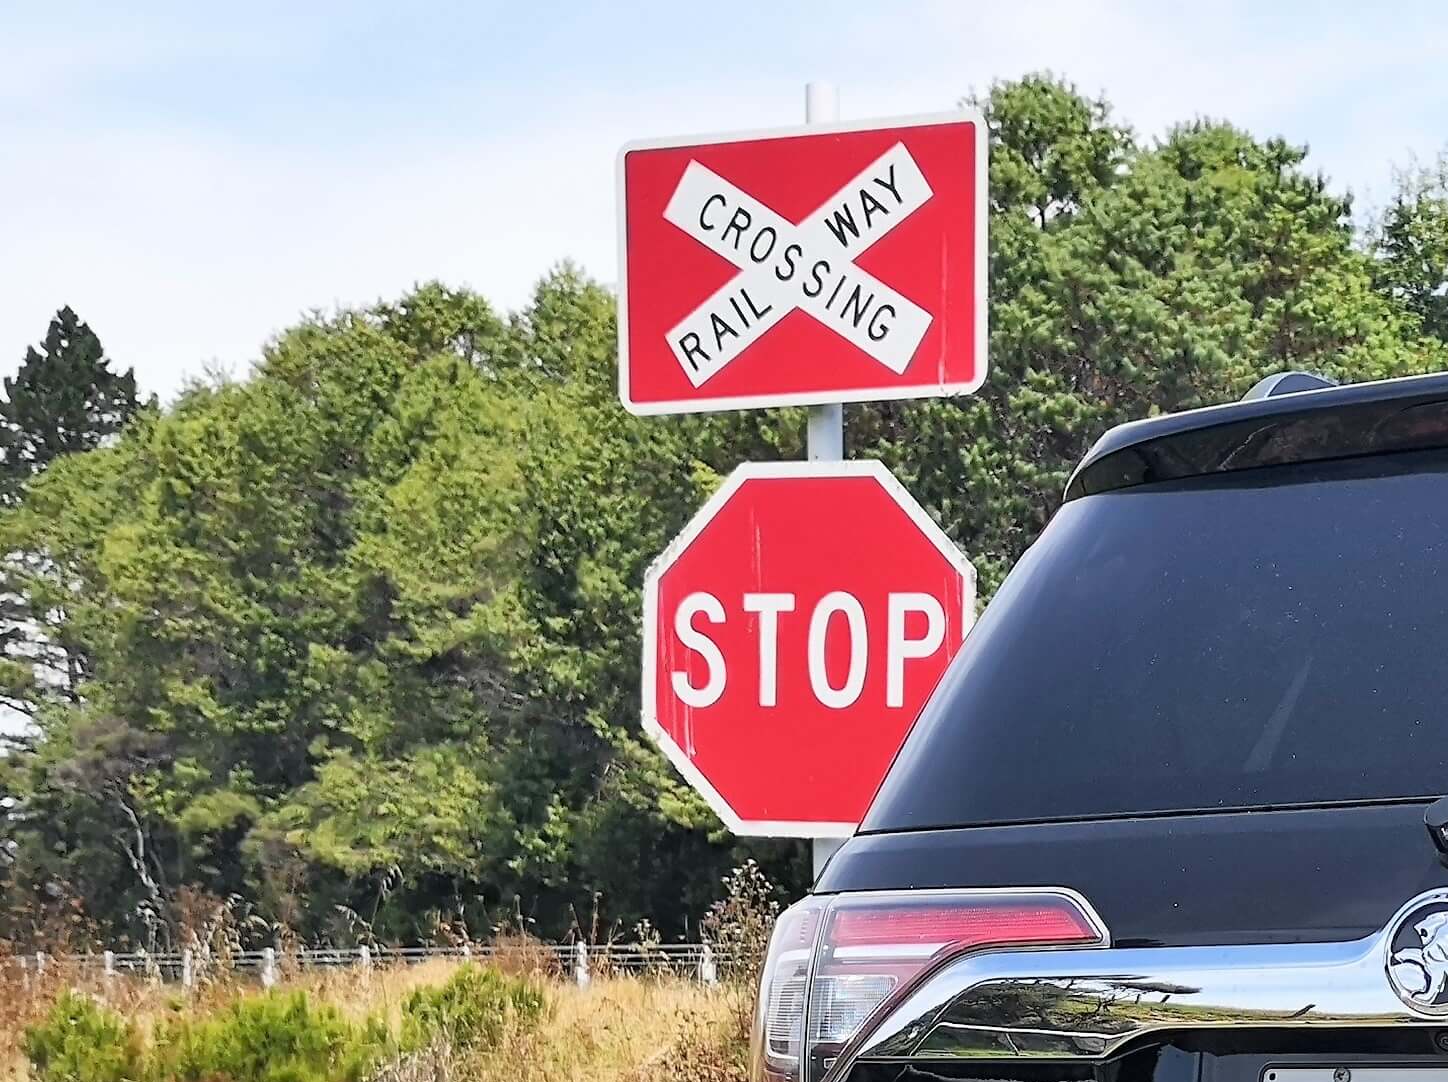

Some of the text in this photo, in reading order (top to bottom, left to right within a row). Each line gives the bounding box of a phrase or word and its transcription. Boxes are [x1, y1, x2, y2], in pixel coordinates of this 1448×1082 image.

[678, 164, 903, 371] RAIL WAY
[699, 194, 896, 341] CROSSING
[671, 591, 946, 709] STOP
